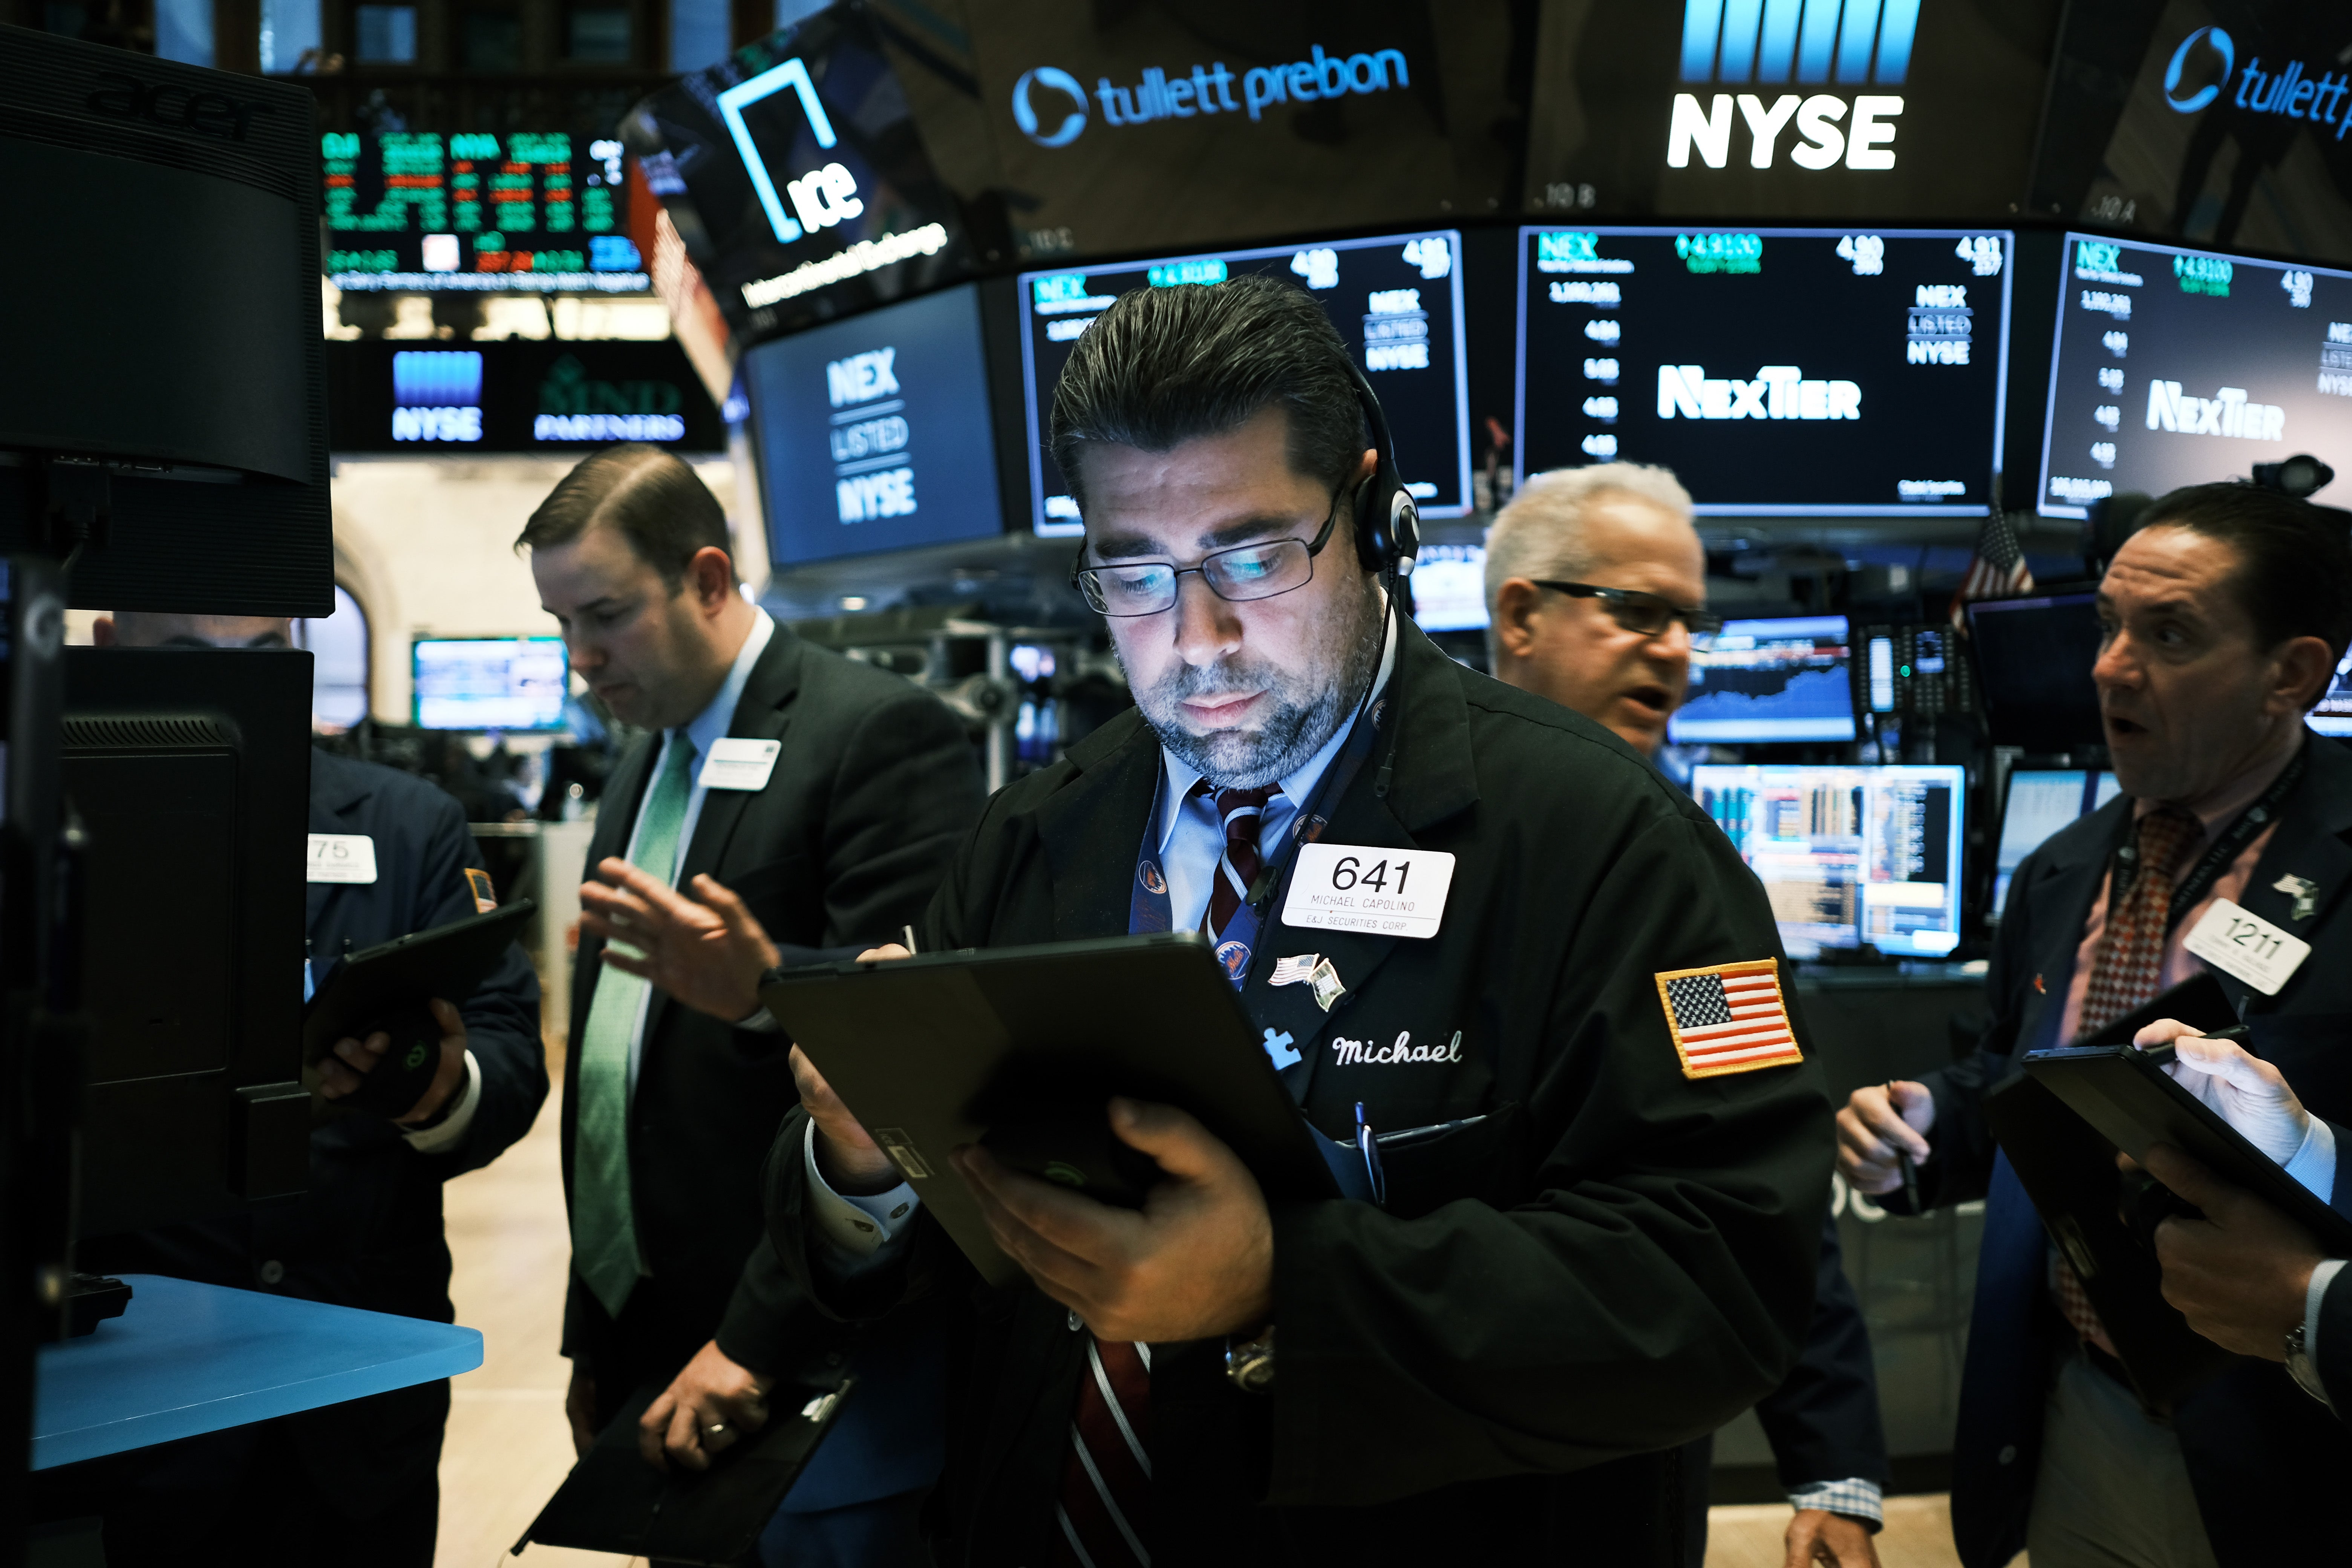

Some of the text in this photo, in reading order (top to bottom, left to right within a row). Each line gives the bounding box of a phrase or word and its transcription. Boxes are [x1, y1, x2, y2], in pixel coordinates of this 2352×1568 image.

[1095, 44, 1410, 126] tullett prebon
[2236, 57, 2349, 124] tullett
[87, 71, 277, 141] acer
[1667, 93, 1904, 170] NYSE
[1538, 231, 1599, 260] NEX
[2076, 240, 2121, 272] NEX
[1916, 285, 1967, 308] NEX
[1908, 315, 1972, 335] LISTED
[1907, 341, 1970, 365] NYSE
[827, 346, 900, 408] NEX
[392, 406, 482, 441] NYSE
[830, 415, 909, 462] LISTED
[836, 467, 917, 525] NYSE
[1332, 857, 1410, 894] 641
[1311, 895, 1415, 911] MICHAEL CAPOLINO
[1306, 915, 1409, 931] E&J SECURITIES CORP.
[2225, 917, 2283, 960] 1211
[1332, 1030, 1462, 1066] Michael
